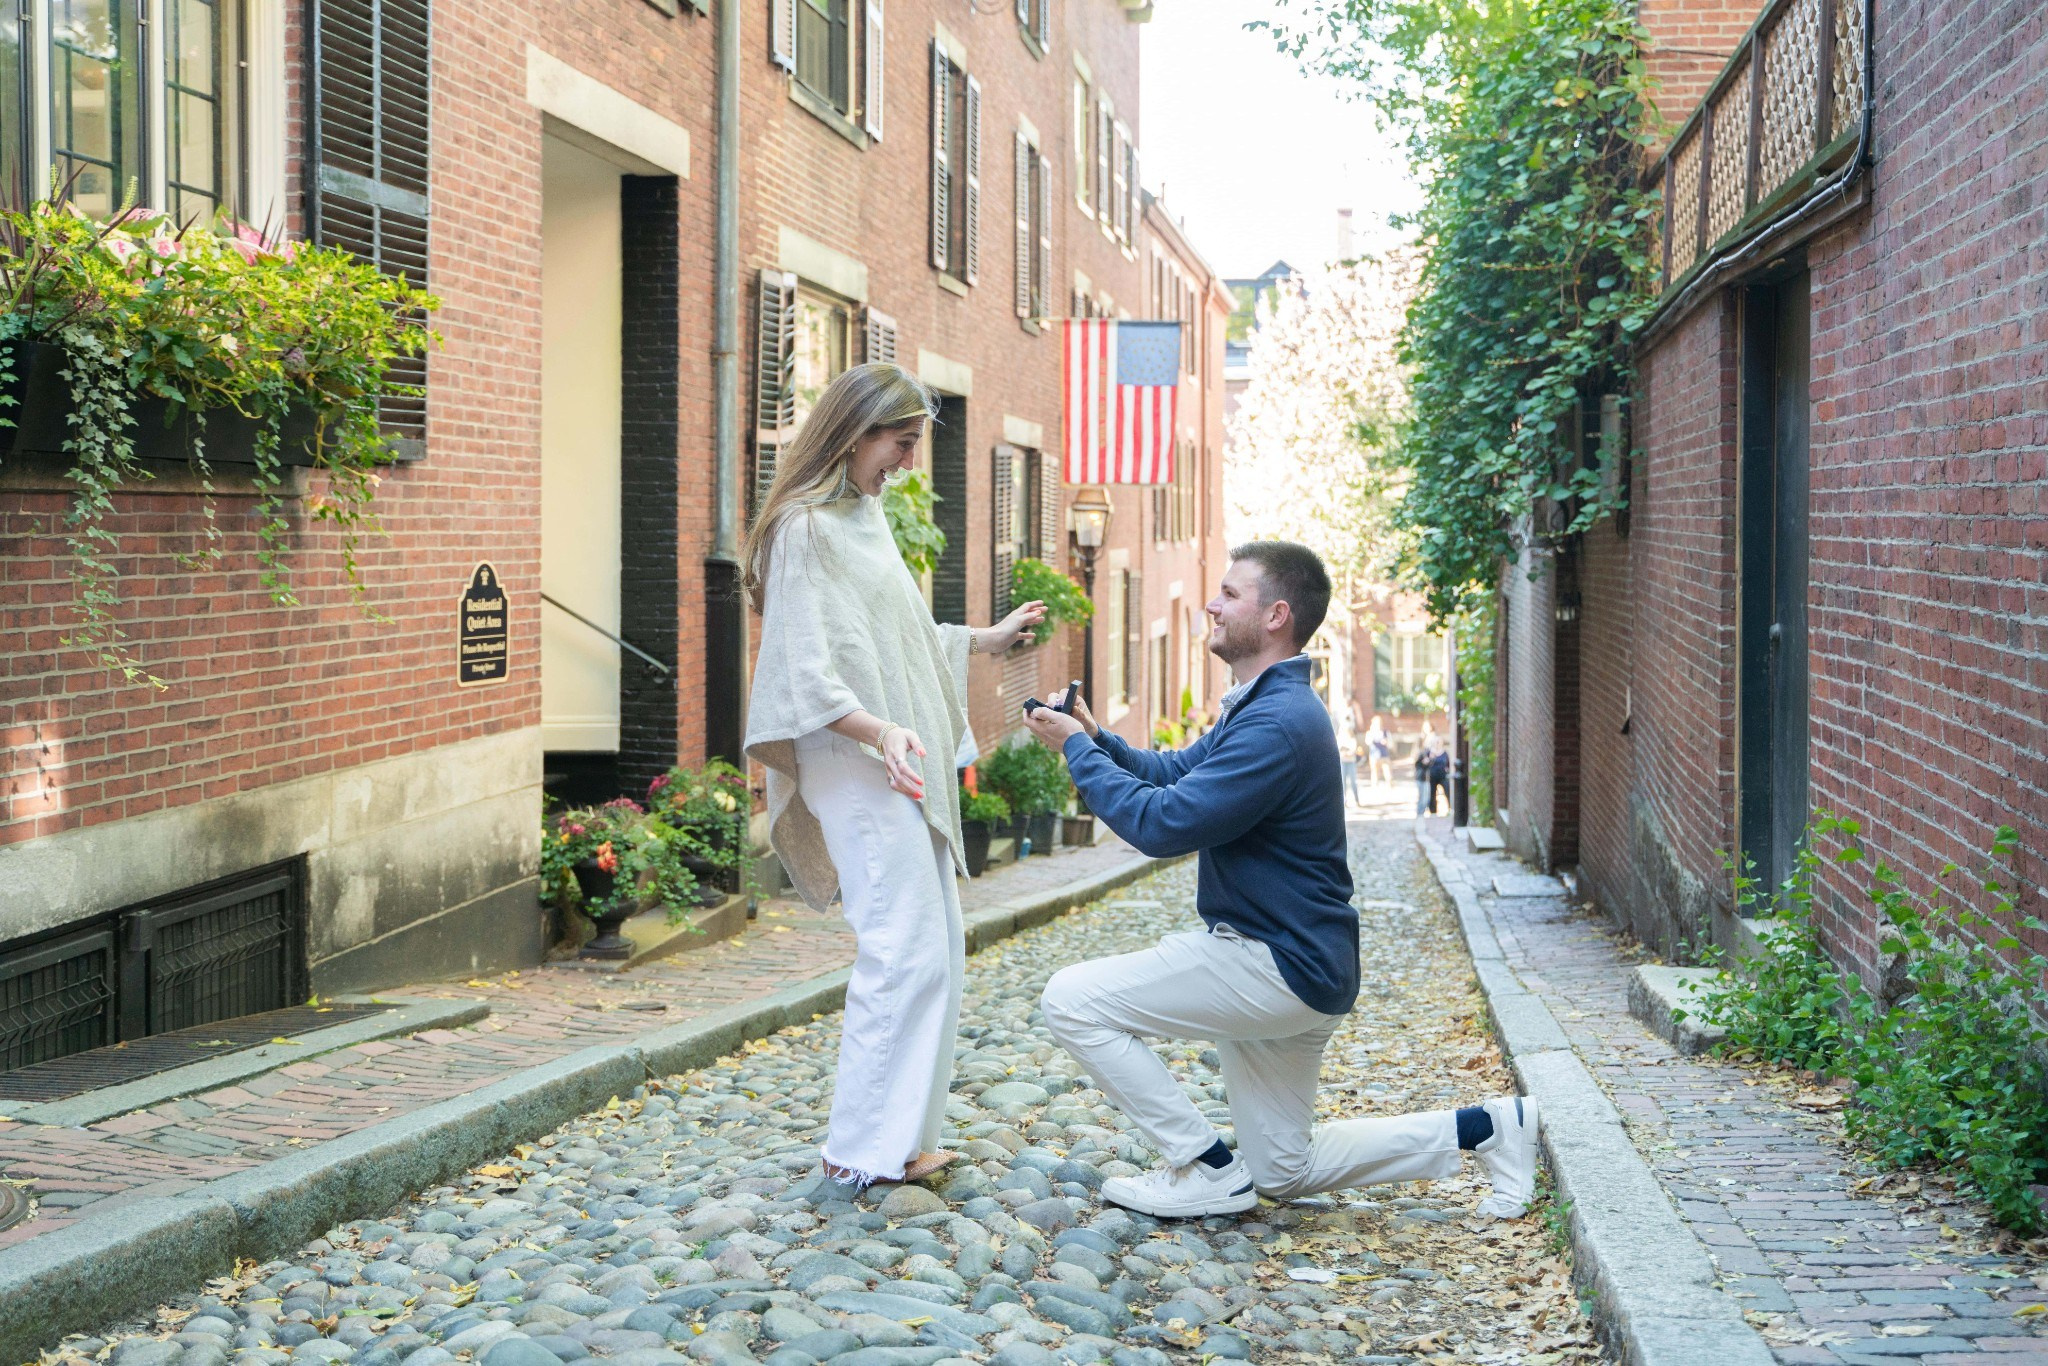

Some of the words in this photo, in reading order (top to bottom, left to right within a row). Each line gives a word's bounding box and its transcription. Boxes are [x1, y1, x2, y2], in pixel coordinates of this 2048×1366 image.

[466, 597, 502, 612] Residential
[467, 616, 486, 632] Quiet
[486, 615, 502, 628] Area
